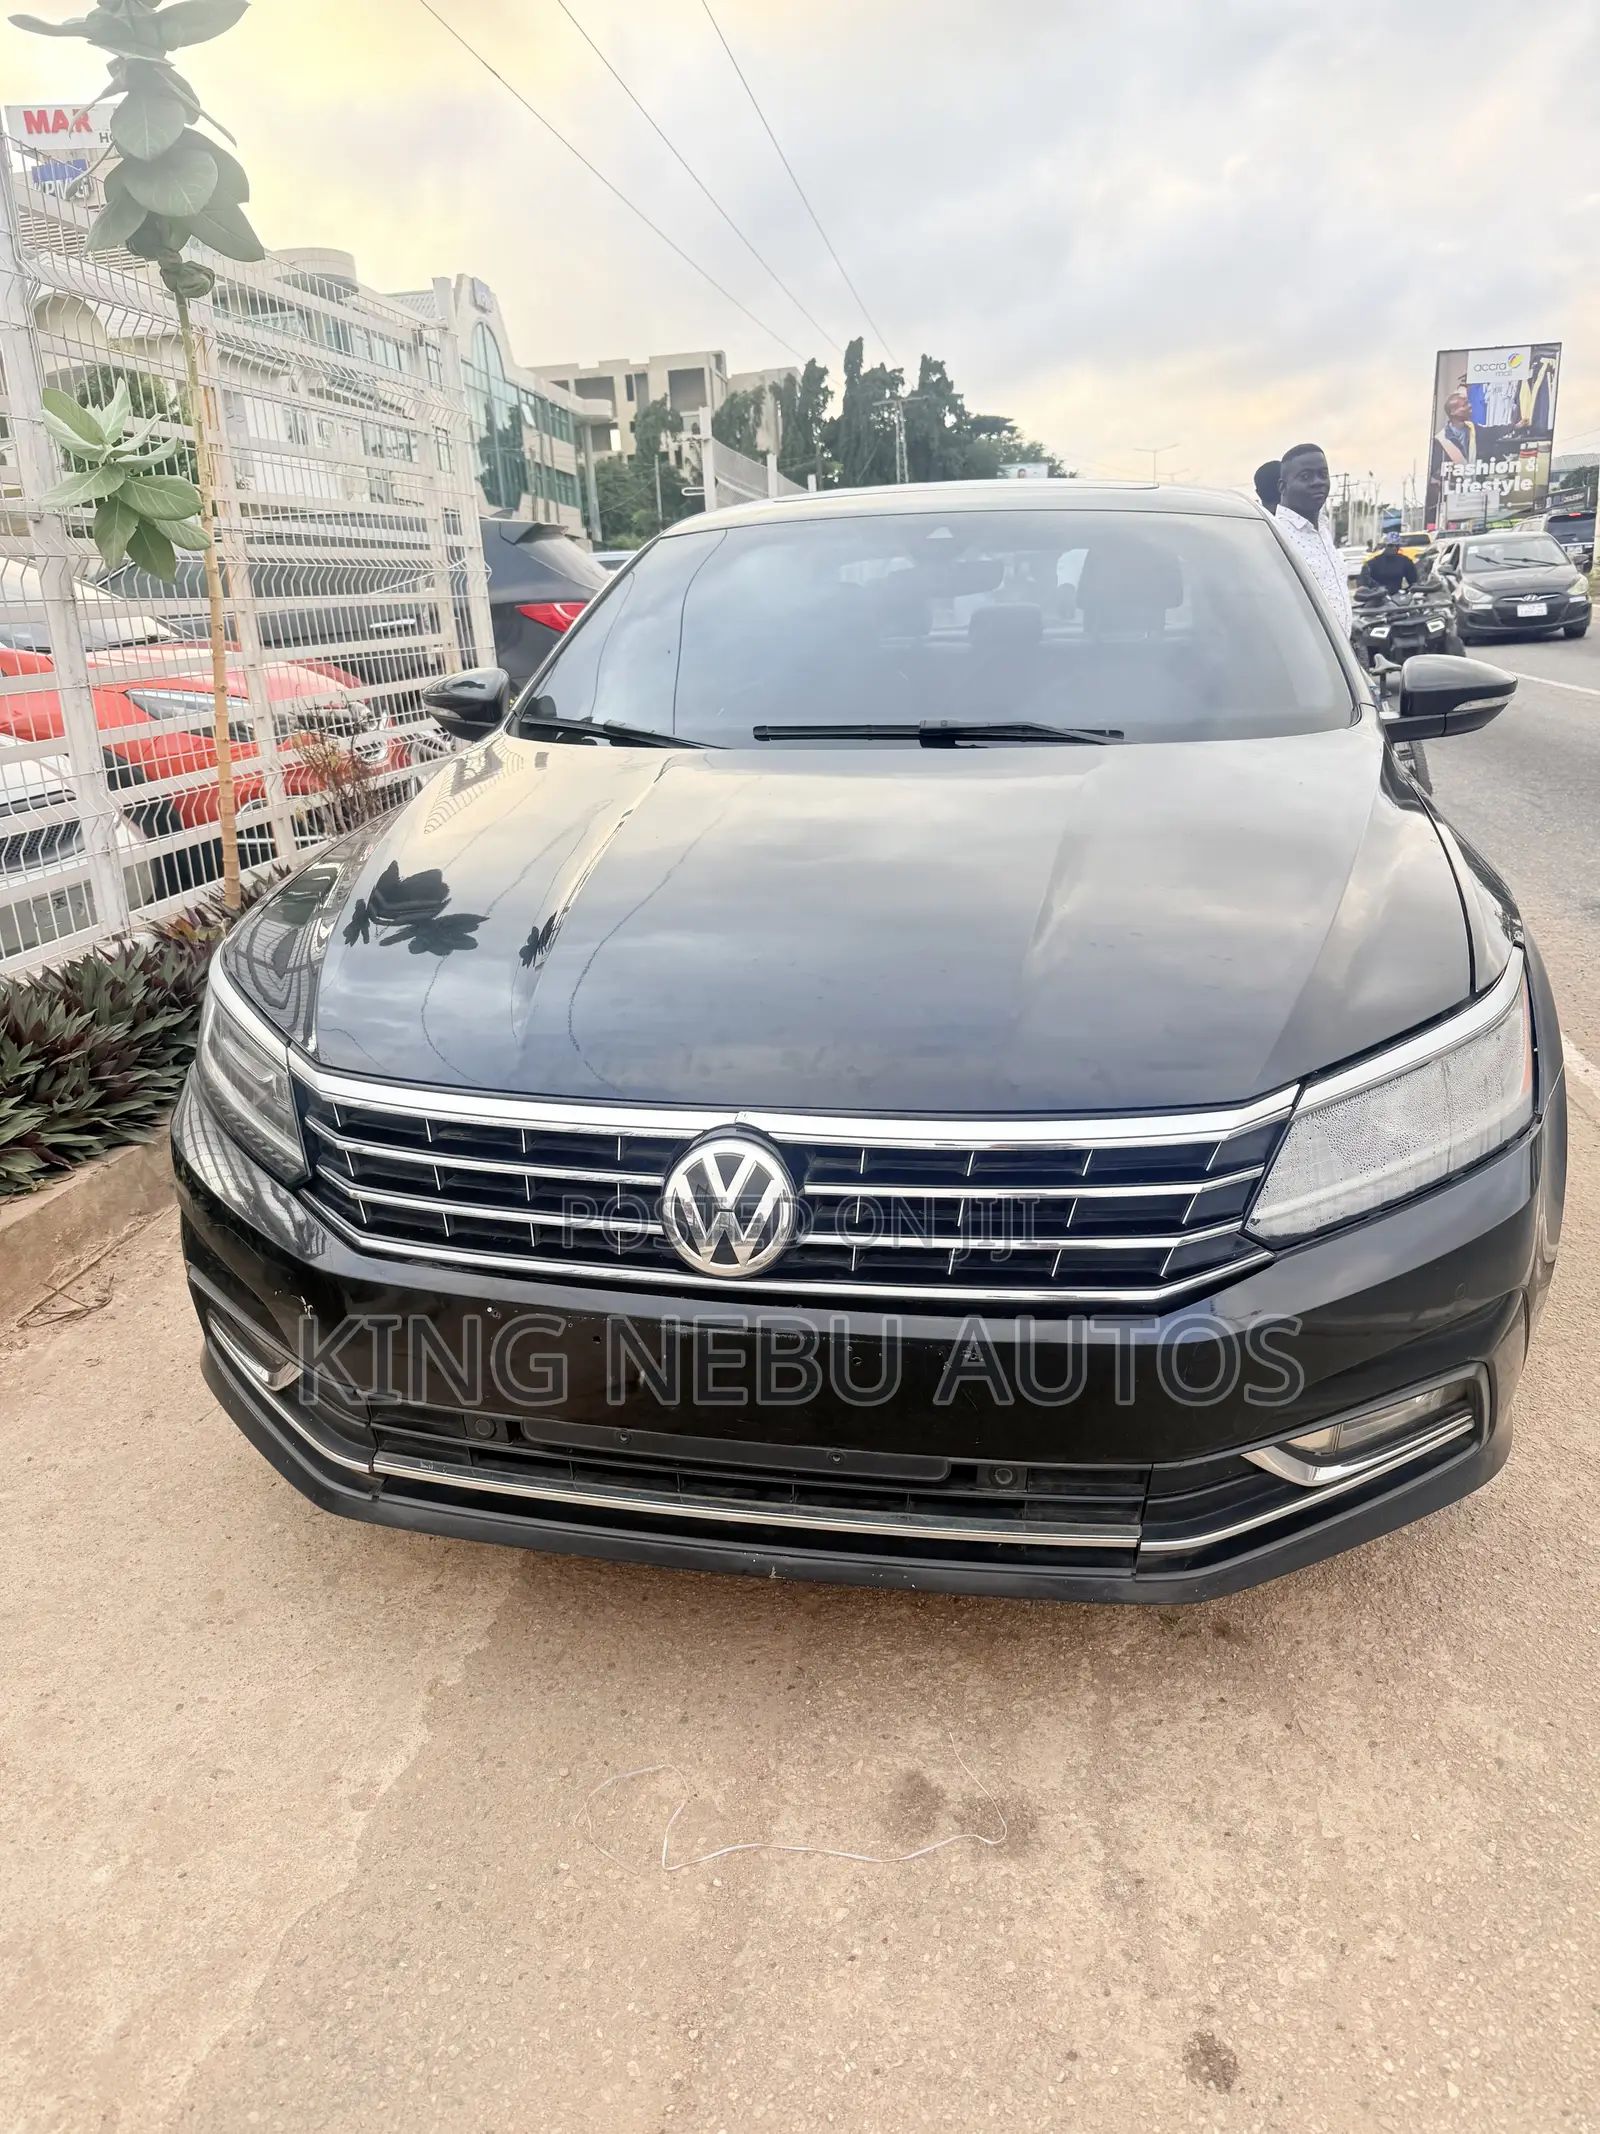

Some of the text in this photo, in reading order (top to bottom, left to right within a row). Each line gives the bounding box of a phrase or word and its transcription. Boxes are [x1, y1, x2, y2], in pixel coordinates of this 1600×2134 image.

[1474, 362, 1507, 372] accra
[1441, 456, 1522, 477] Fashion
[1443, 475, 1534, 497] Lifestyle
